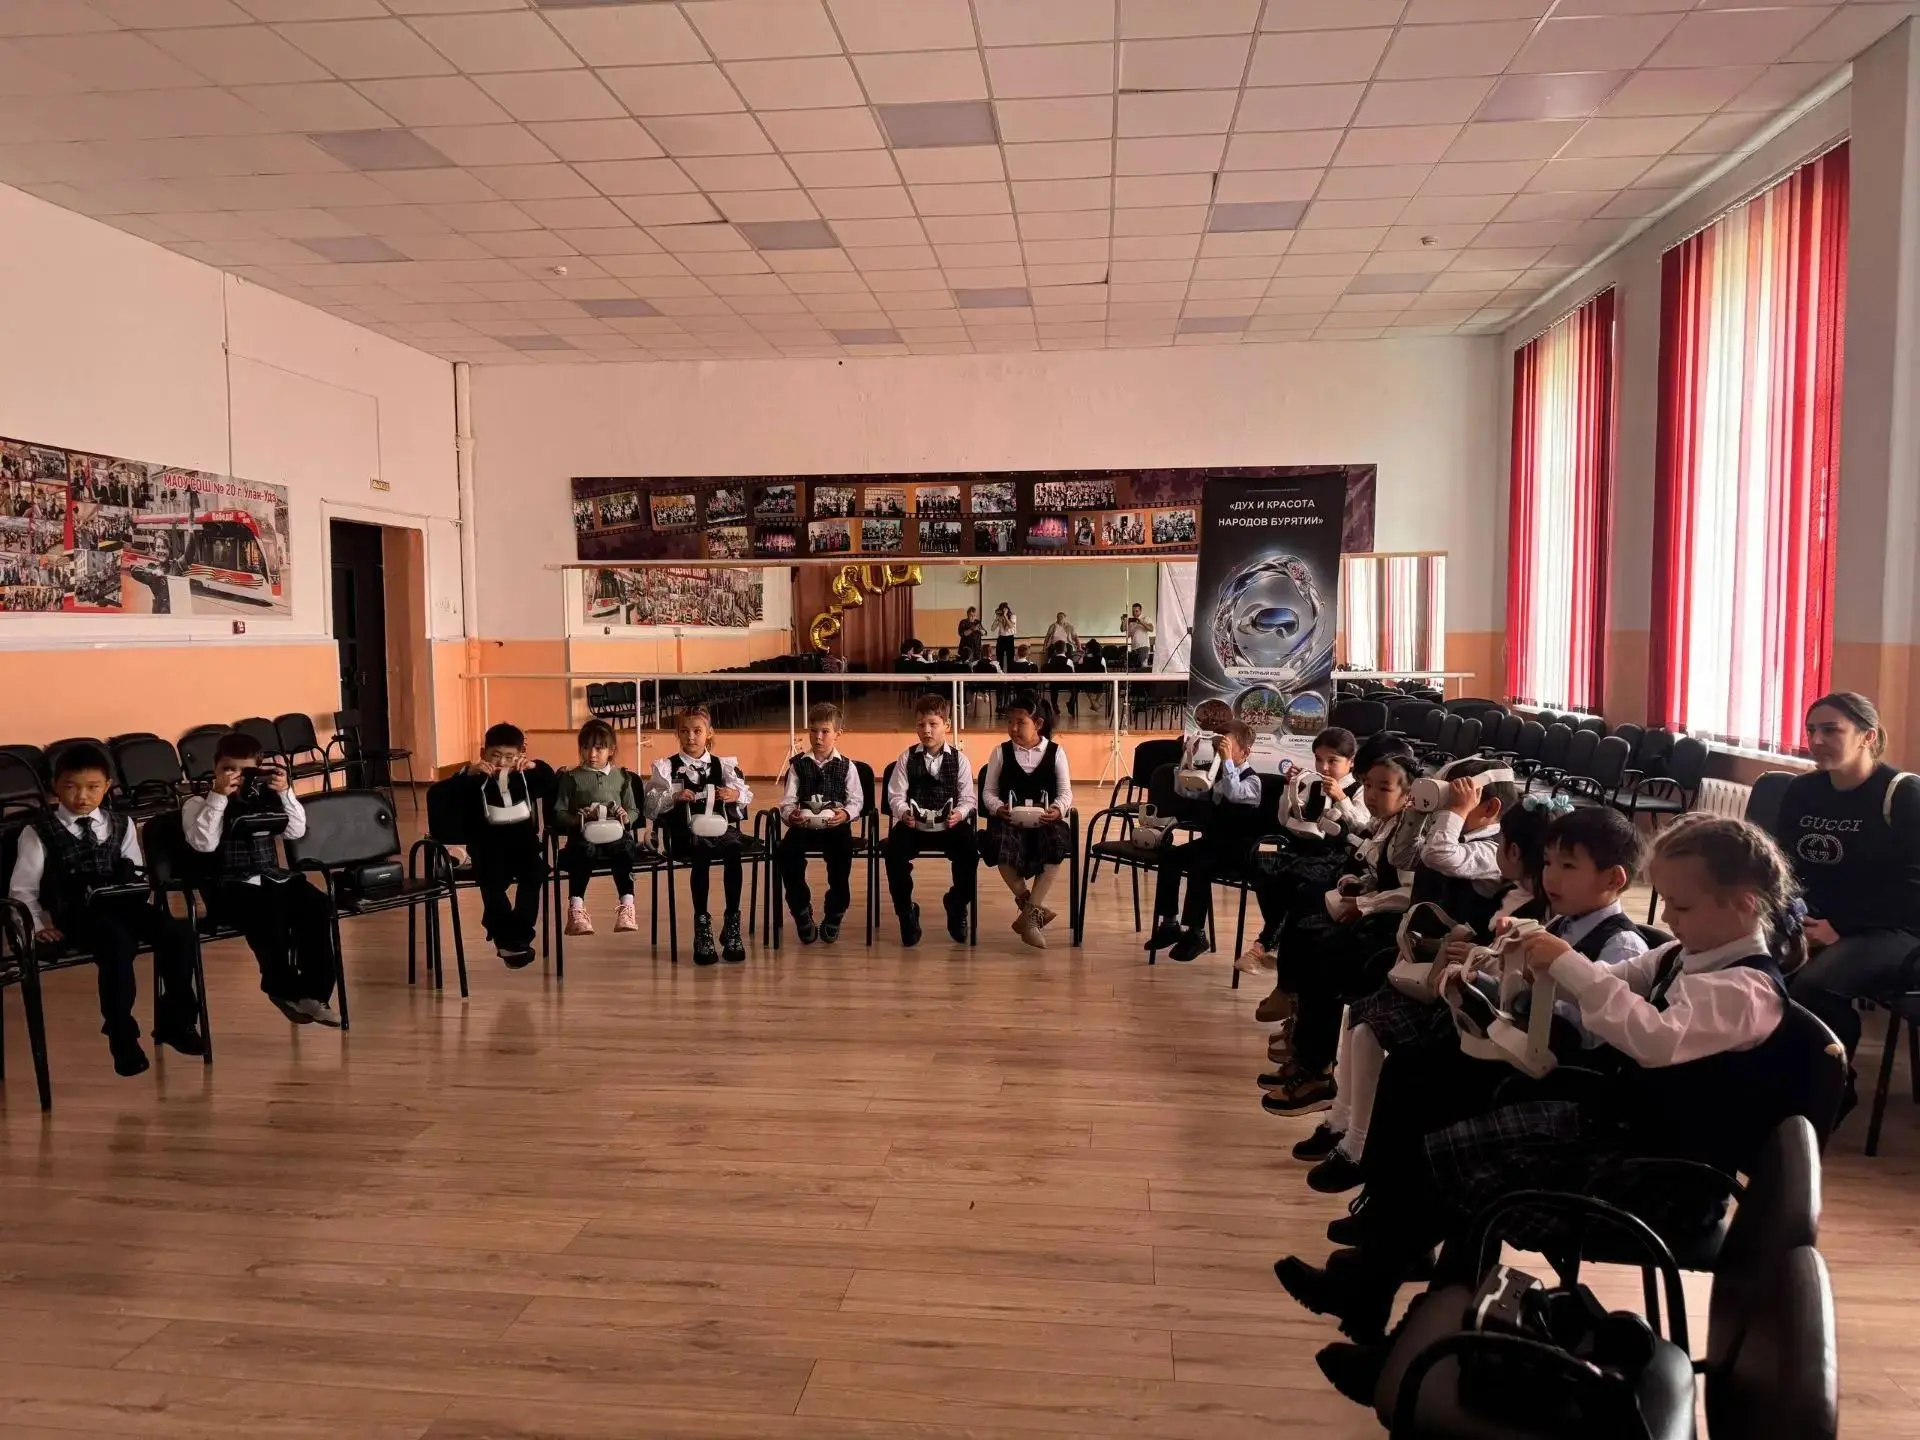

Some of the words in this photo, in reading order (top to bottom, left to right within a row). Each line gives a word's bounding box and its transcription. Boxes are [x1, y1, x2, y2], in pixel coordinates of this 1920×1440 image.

[163, 473, 191, 491] МАОУ
[190, 478, 211, 493] СОШ
[226, 484, 236, 497] 20
[244, 487, 277, 503] Улан-Удэ
[1229, 501, 1255, 511] «ДУХ
[1256, 501, 1264, 509] И
[1266, 499, 1315, 509] КРАСОТА
[1218, 517, 1268, 528] НАРОДОВ
[1270, 516, 1324, 527] БУРЯТИИ»
[1800, 815, 1863, 832] GUCCI
